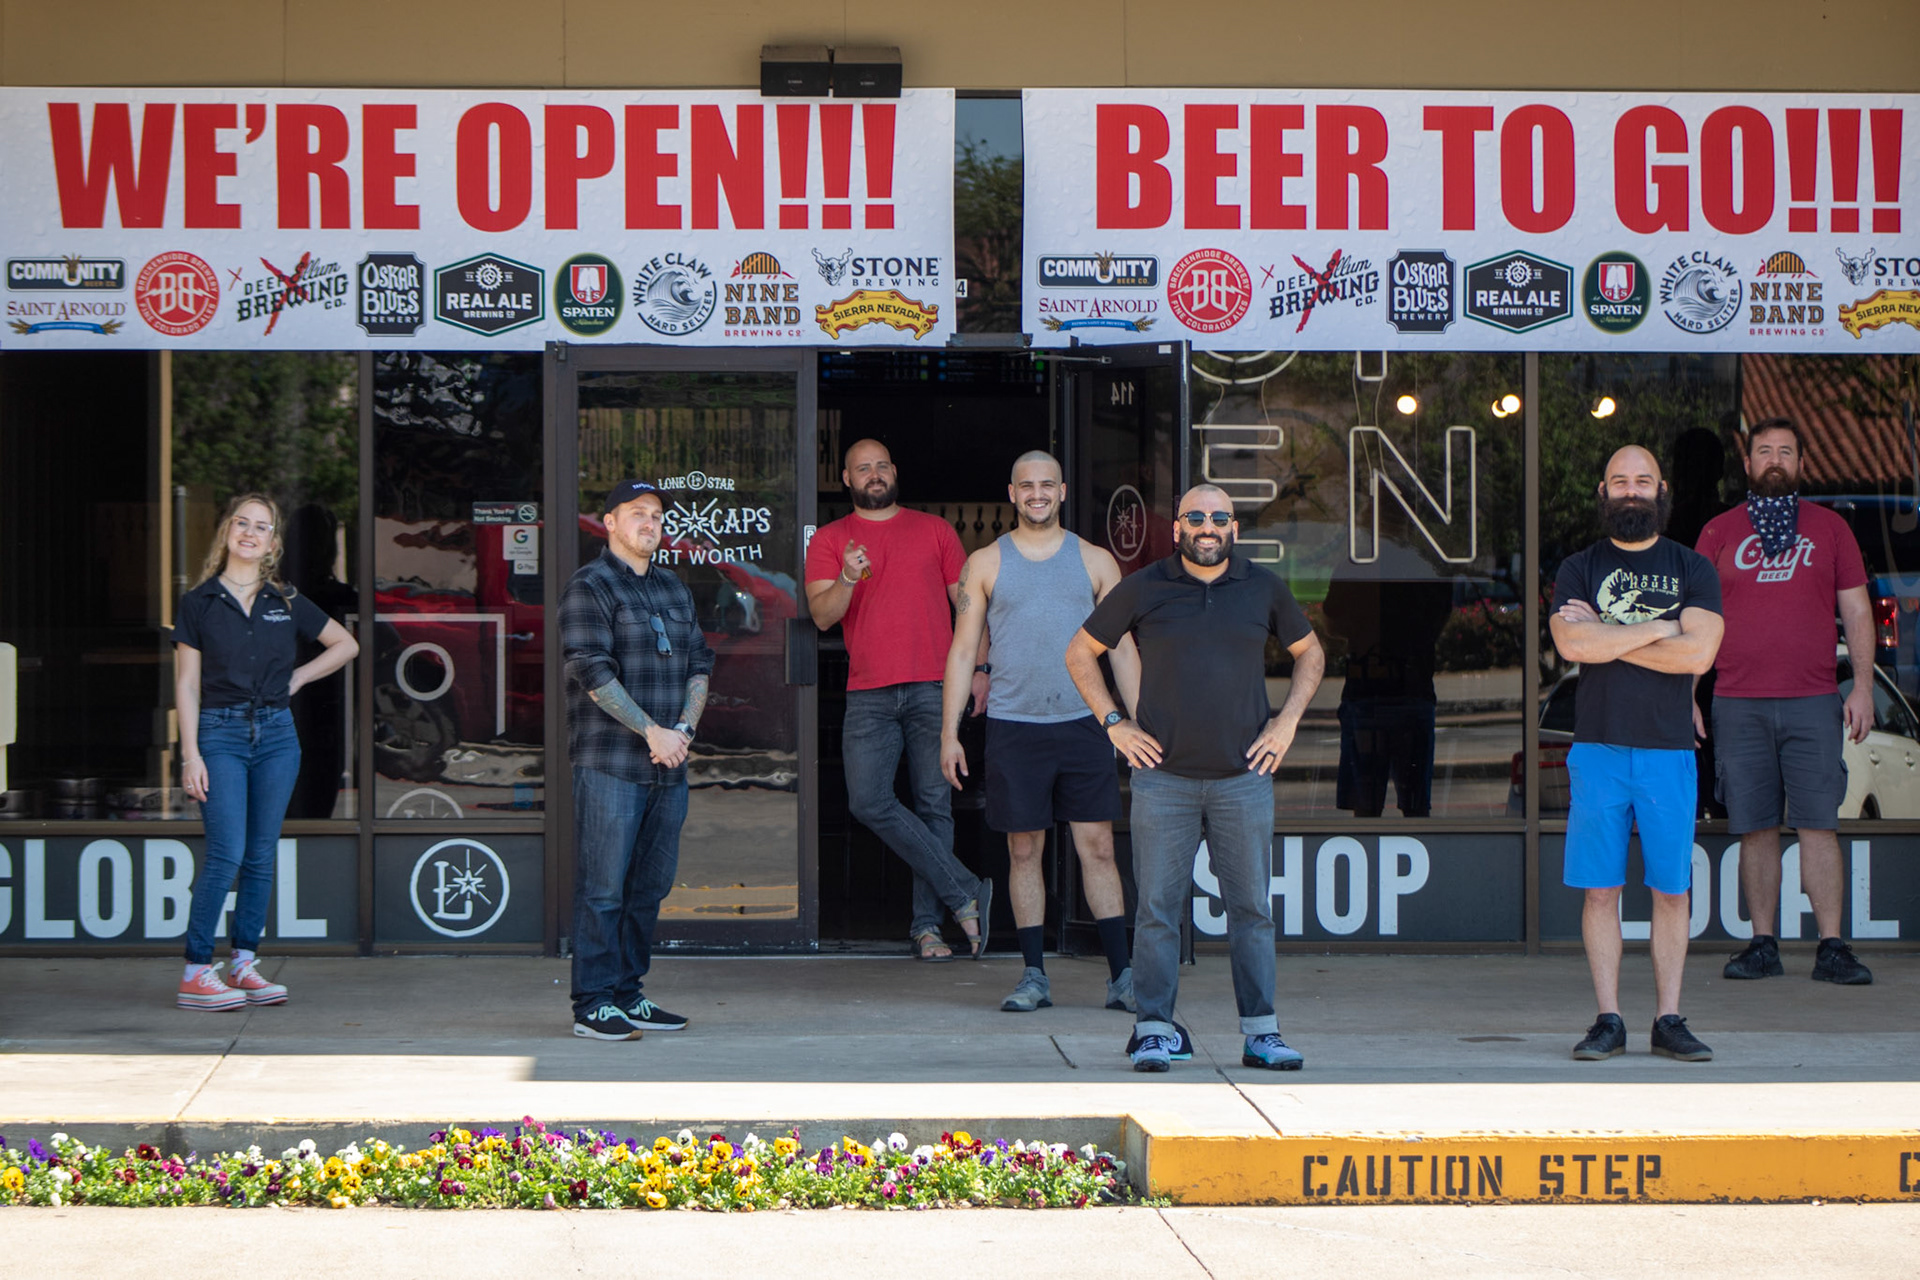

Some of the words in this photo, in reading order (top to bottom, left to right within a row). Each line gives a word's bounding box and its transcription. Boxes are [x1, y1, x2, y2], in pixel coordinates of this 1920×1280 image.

[47, 101, 421, 230] WE'RE
[455, 101, 897, 232] OPEN!!!
[1095, 104, 1390, 231] BEER
[1422, 104, 1576, 233] TO
[1613, 104, 1904, 235] GO!!!
[10, 262, 121, 286] COMMUNITY
[137, 253, 189, 291] BRECKENRIDGE
[190, 257, 218, 292] BREWERY
[362, 261, 420, 291] OSKAR
[851, 257, 939, 277] STONE
[1043, 259, 1153, 284] COMMUNITY
[1169, 250, 1222, 288] BRECKENRIDGE
[1223, 254, 1250, 290] BREWERY
[1276, 271, 1317, 293] DEEP
[1321, 254, 1372, 281] Ellum
[1393, 259, 1450, 288] OSKAR
[1659, 255, 1689, 305] WHITE
[1691, 250, 1738, 278] CLAW
[244, 274, 286, 296] DEEP
[633, 257, 663, 307] WHITE
[664, 252, 712, 279] CLAW
[852, 278, 939, 287] BREWING
[237, 273, 349, 322] BREWING
[362, 289, 420, 315] BLUES
[446, 292, 495, 310] REAL
[497, 292, 533, 310] ALE
[725, 283, 799, 302] NINE
[1269, 270, 1380, 320] BREWING
[1355, 295, 1377, 307] CO.
[1393, 286, 1449, 312] BLUES
[1475, 289, 1524, 306] REAL
[1526, 290, 1561, 307] ALE
[1750, 282, 1823, 301] NINE
[7, 301, 56, 316] SAINT
[55, 300, 126, 320] ARNOLD
[139, 303, 155, 323] FINE
[154, 321, 201, 334] COLORADO
[463, 310, 504, 318] BREWING
[562, 307, 615, 317] SPATEN
[647, 313, 677, 332] HARD
[681, 290, 713, 331] SELTZER
[725, 306, 801, 325] BAND
[833, 305, 875, 321] SIERRA
[877, 303, 921, 321] NEVADA
[1038, 297, 1088, 313] SAINT
[1087, 297, 1158, 318] ARNOLD
[1171, 300, 1186, 320] FINE
[1186, 318, 1232, 332] COLORADO
[1232, 300, 1248, 321] ALES
[1393, 312, 1449, 321] BREWERY
[1492, 307, 1533, 316] BREWING
[1590, 304, 1642, 315] SPATEN
[1673, 311, 1703, 330] HARD
[1707, 288, 1738, 329] SELTZER
[1750, 305, 1825, 324] BAND
[1856, 304, 1896, 321] SIERRA
[724, 329, 782, 337] BREWING
[1749, 328, 1806, 336] BREWING
[658, 478, 686, 490] LONE
[707, 477, 735, 491] STAR
[709, 507, 772, 535] CAPS
[651, 549, 682, 565] RT
[689, 543, 763, 565] WORTH
[1629, 579, 1679, 592] HOUSE
[1761, 571, 1789, 580] BEER
[0, 838, 328, 940] LOBL
[1192, 836, 1431, 936] SHOP
[1302, 1153, 1503, 1197] CAUTION
[1538, 1153, 1662, 1196] STEP
